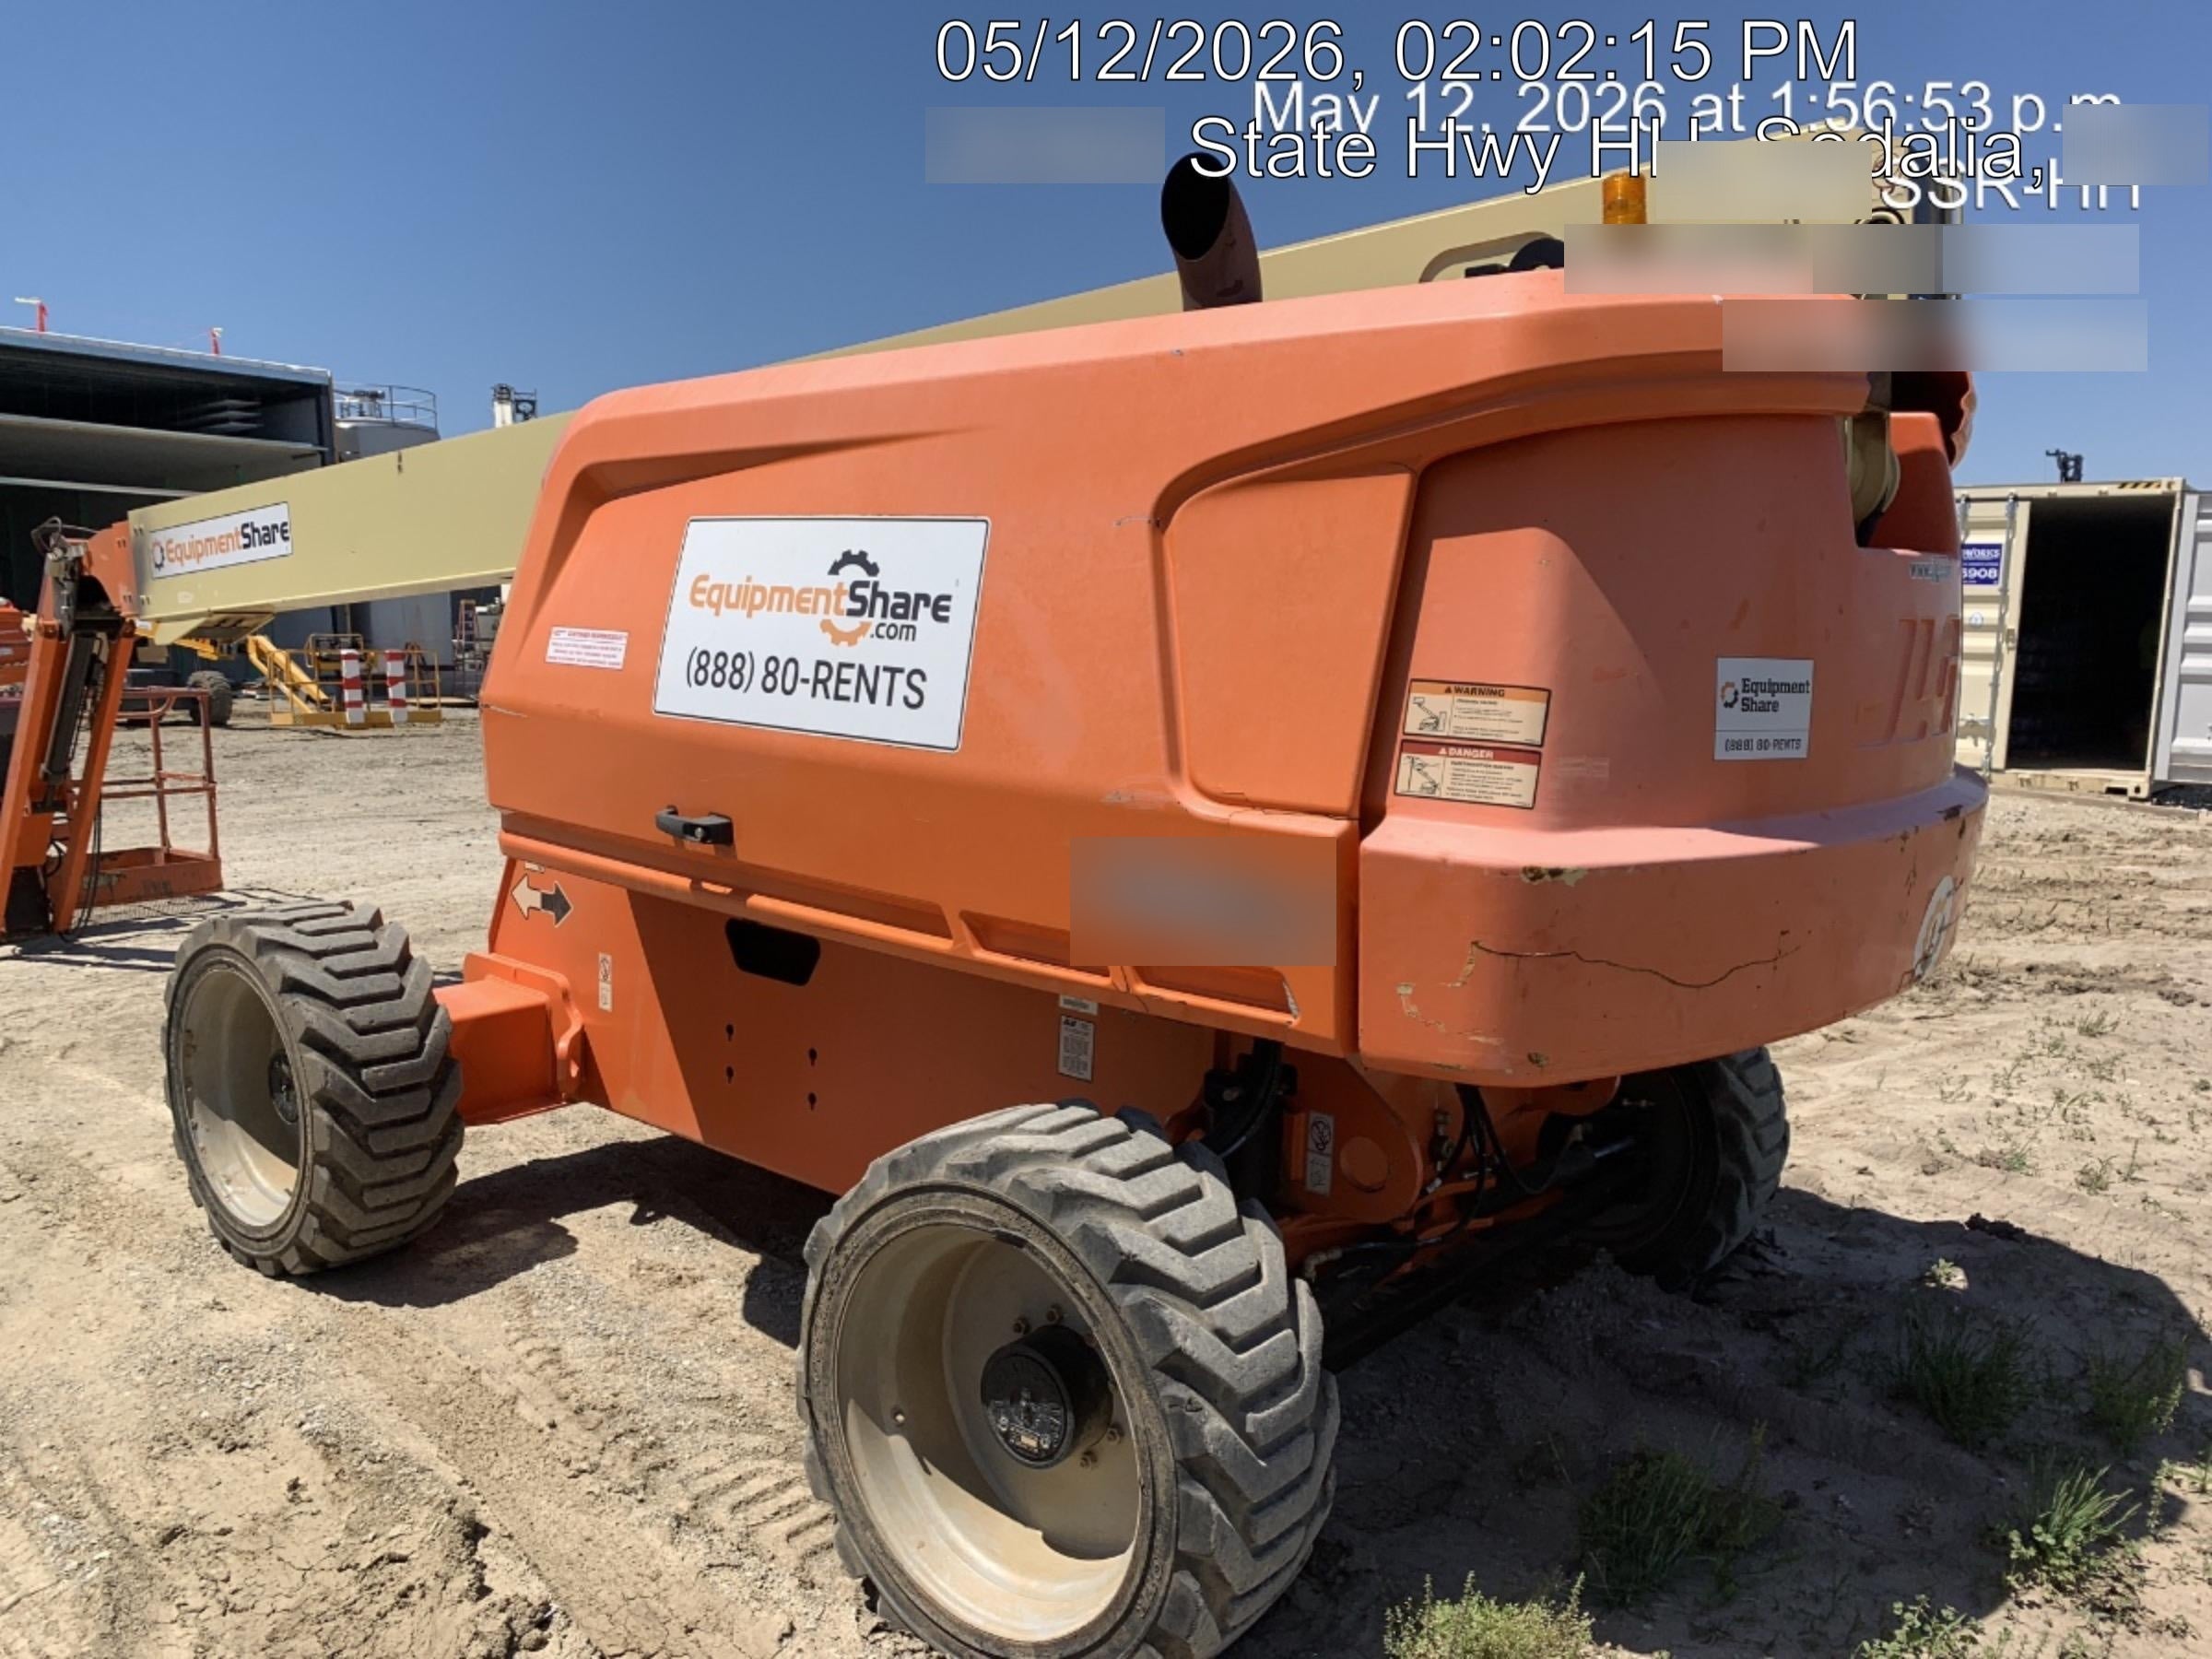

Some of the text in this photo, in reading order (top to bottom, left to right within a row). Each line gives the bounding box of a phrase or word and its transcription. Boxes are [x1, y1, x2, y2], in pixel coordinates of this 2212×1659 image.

[165, 521, 290, 567] EquipmentShare
[689, 572, 952, 623] EquipmentShare
[869, 621, 917, 642] .com
[686, 646, 755, 694] (888)
[760, 654, 928, 711] 80-RENTS
[1741, 677, 1811, 698] Equipment
[1454, 686, 1505, 698] WARNING
[1741, 697, 1780, 712] Share
[1449, 748, 1494, 759] DANGER
